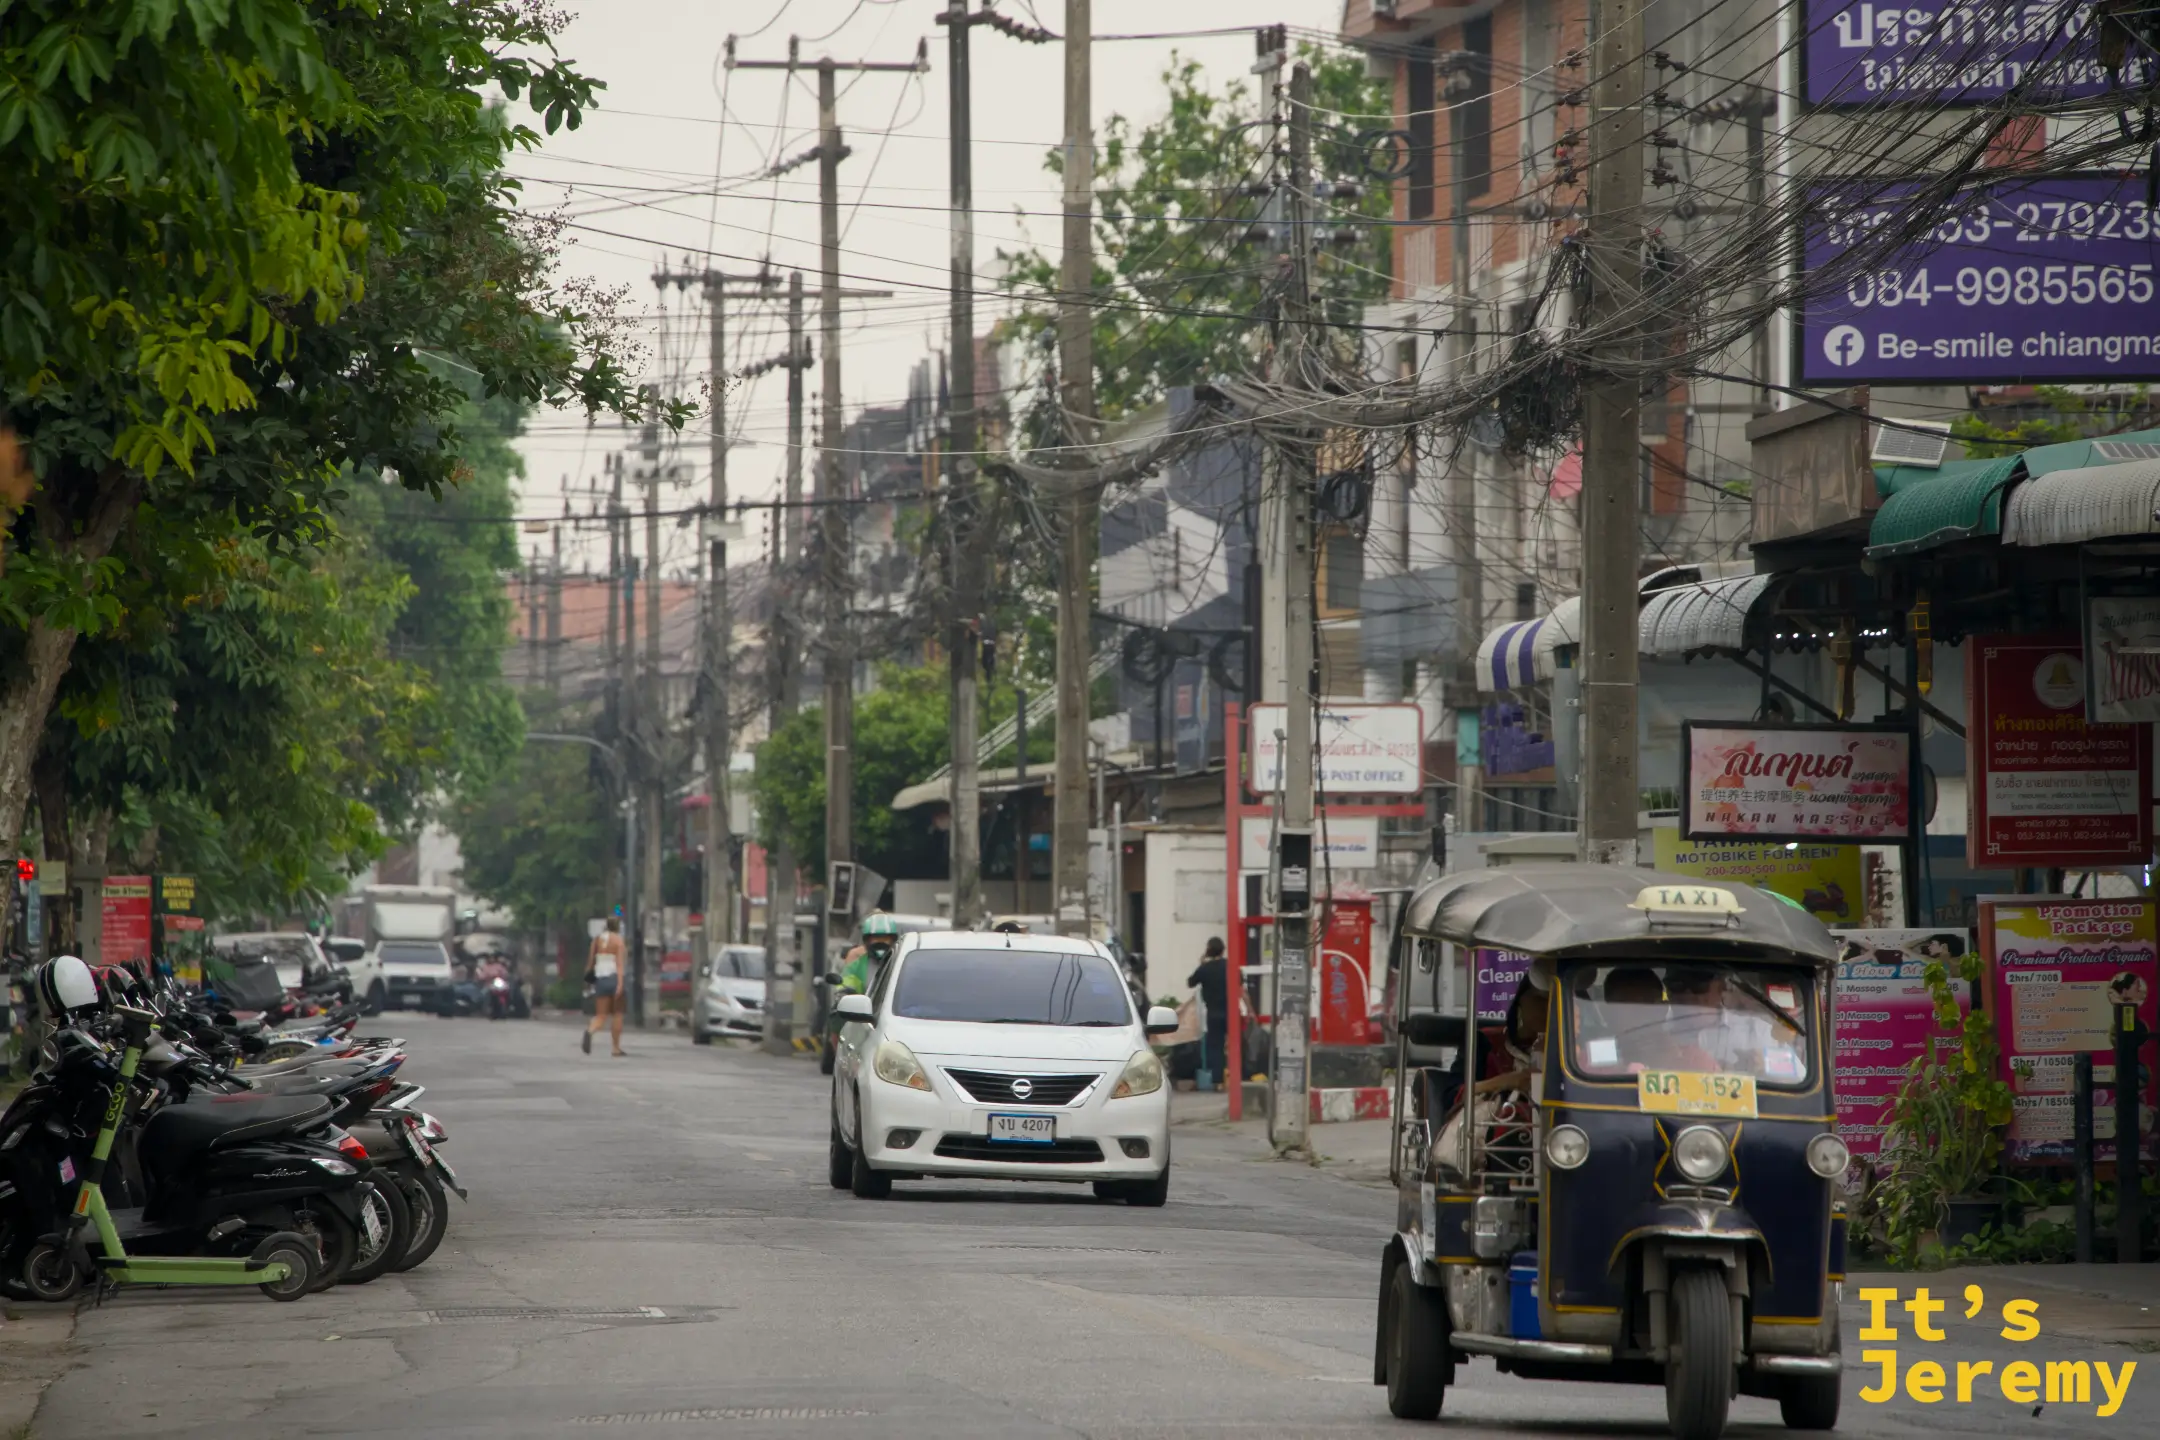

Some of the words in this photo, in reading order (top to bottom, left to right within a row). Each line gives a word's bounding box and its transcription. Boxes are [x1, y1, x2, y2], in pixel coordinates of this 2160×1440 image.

[1847, 264, 2153, 307] 084-9985565
[1878, 333, 2013, 359] Be-smile
[1332, 769, 1360, 781] POST
[1364, 769, 1405, 782] OFFICE
[1701, 789, 1805, 804] 提供养生按摩服务
[1705, 812, 1776, 823] NAKAN
[1676, 851, 1757, 863] MOTOBIKE
[1763, 848, 1795, 860] FOR
[1800, 847, 1840, 858] RENT
[1705, 865, 1776, 877] 200-250-500
[1787, 863, 1811, 873] DAY
[1658, 888, 1719, 906] TAXI
[2039, 904, 2143, 918] Promotion
[2052, 921, 2132, 935] Package
[2002, 951, 2056, 966] Premium
[2056, 949, 2105, 965] Product
[2107, 947, 2152, 965] Organic
[1478, 966, 1529, 984] Clean
[1855, 966, 1893, 976] Hour
[1491, 991, 1508, 1001] full
[1846, 985, 1888, 994] Massage
[1848, 1012, 1889, 1022] Massage
[1851, 1039, 1892, 1049] Massage
[1701, 1076, 1743, 1098] 152
[1021, 1119, 1052, 1132] 4207
